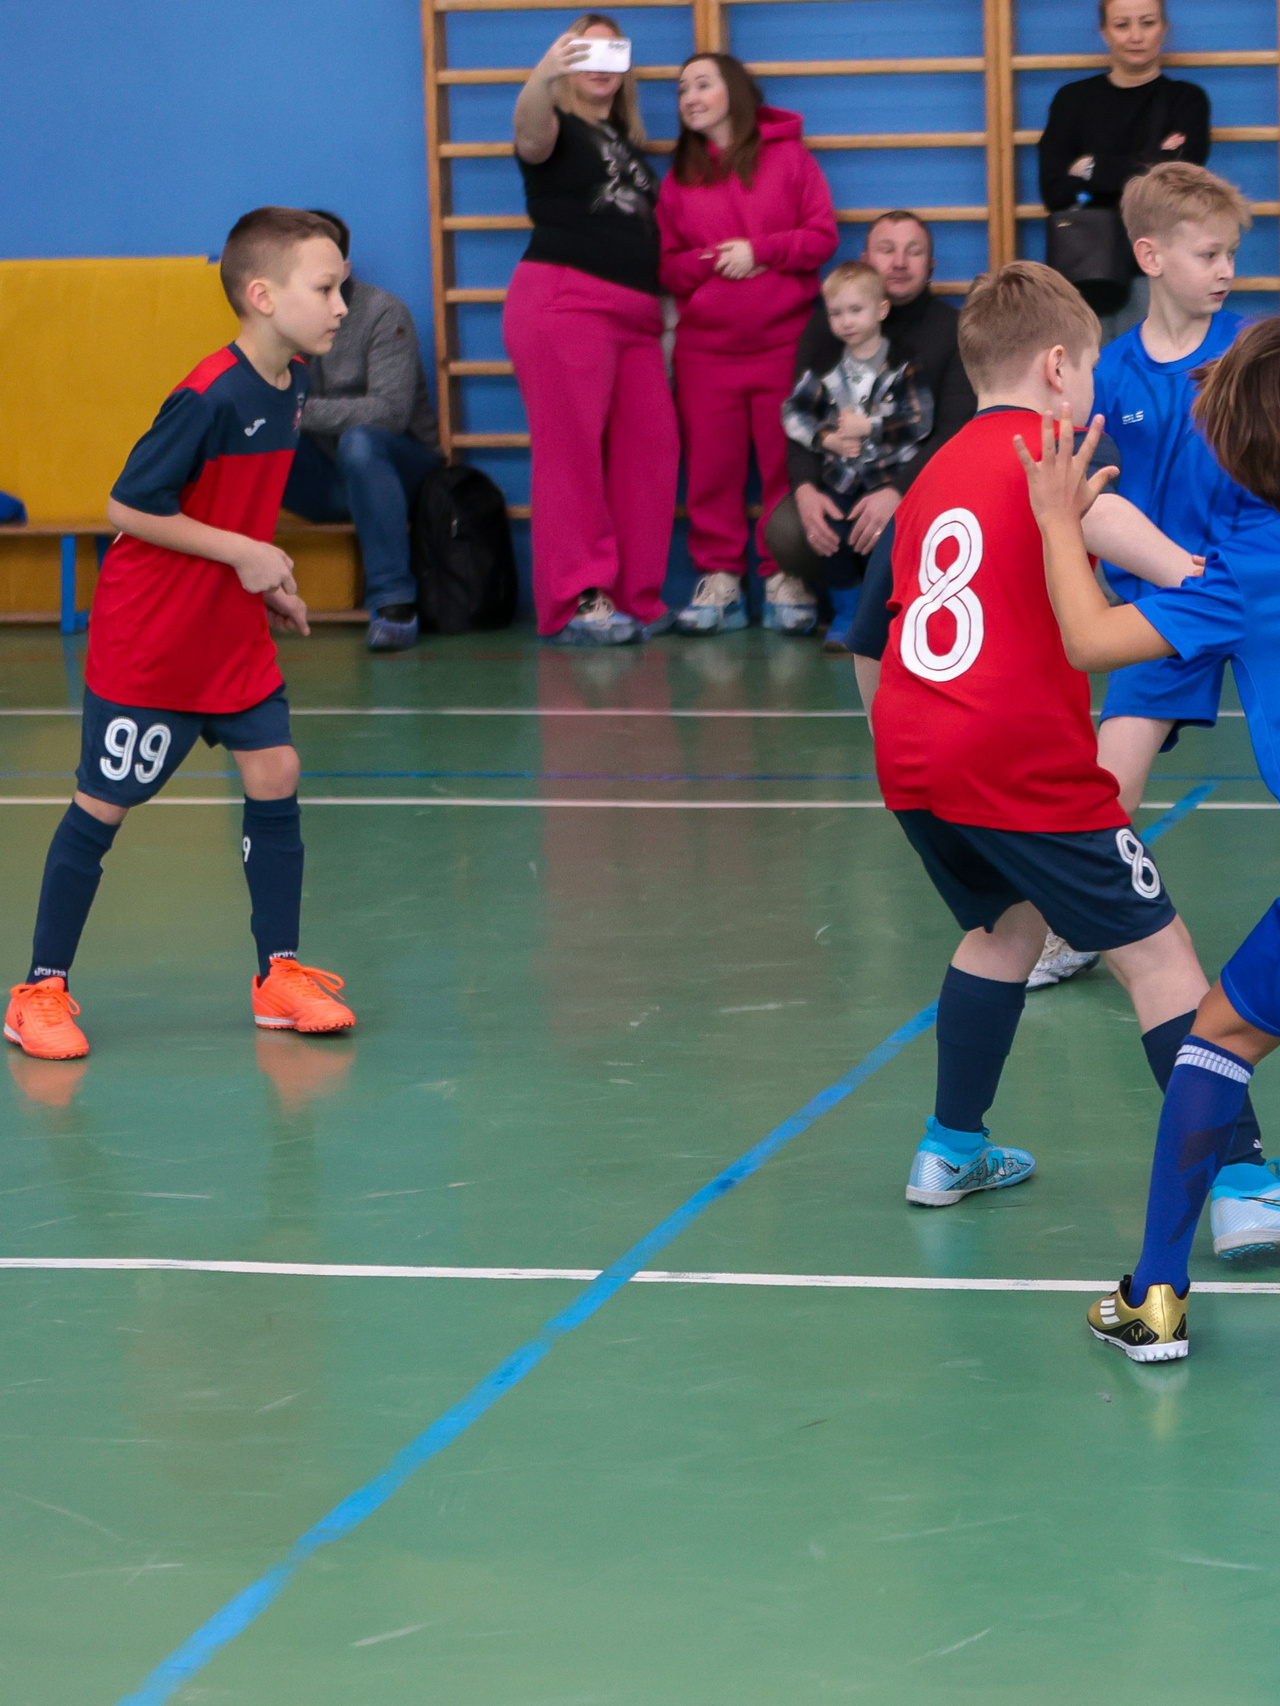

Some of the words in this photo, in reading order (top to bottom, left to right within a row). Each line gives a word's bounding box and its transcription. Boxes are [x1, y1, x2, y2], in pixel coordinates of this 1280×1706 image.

[900, 507, 985, 683] 8
[100, 716, 172, 784] 99
[1115, 828, 1161, 899] 8
